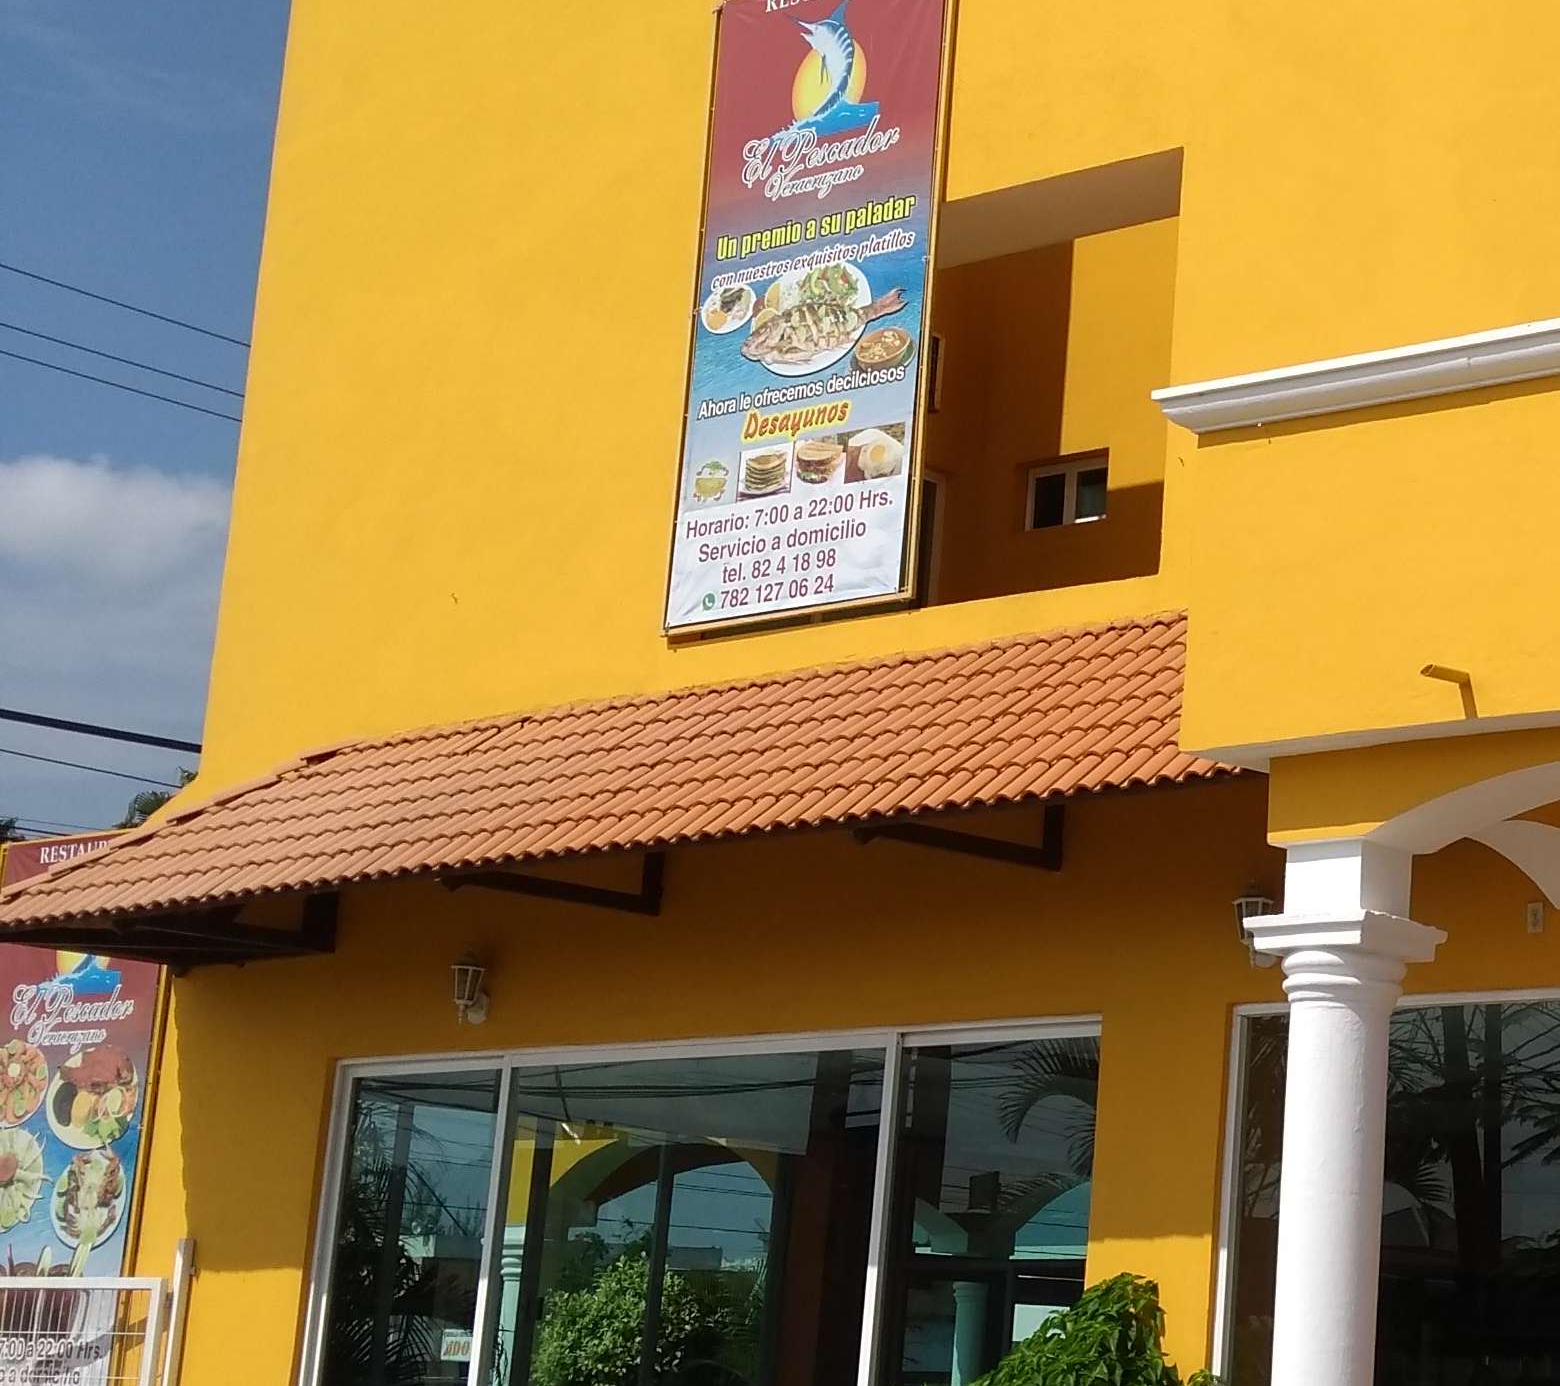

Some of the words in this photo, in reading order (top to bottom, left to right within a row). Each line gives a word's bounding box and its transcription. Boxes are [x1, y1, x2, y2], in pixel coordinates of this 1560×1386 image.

[742, 138, 779, 188] El
[780, 115, 900, 173] Pescador
[765, 165, 864, 201] Veracruzano
[716, 235, 738, 261] Un
[740, 220, 802, 259] premio
[805, 220, 816, 241] a
[820, 214, 841, 237] su
[844, 195, 916, 235] paladar
[711, 273, 736, 291] con
[737, 260, 792, 286] nuestros
[793, 244, 856, 274] exquisitos
[858, 229, 915, 262] platillos
[697, 395, 737, 420] Ahora
[739, 392, 752, 411] le
[753, 380, 823, 409] ofrecemos
[826, 365, 905, 394] decilciosos
[742, 401, 851, 441] Desayunos
[686, 513, 749, 539] Horario:
[754, 504, 789, 528] 7:00
[793, 506, 803, 520] a
[807, 493, 854, 518] 22:00
[859, 489, 893, 510] Hrs.
[698, 536, 766, 562] Servicio
[771, 535, 781, 550] a
[786, 518, 866, 548] domicilio
[722, 563, 746, 583] tel.
[752, 558, 771, 579] 82
[776, 556, 786, 575] 4
[793, 552, 811, 573] 18
[816, 548, 837, 569] 98
[720, 587, 749, 609] 782
[755, 582, 784, 604] 127
[788, 578, 809, 599] 06
[814, 574, 834, 595] 24
[10, 985, 43, 1031] El
[43, 984, 134, 1025] Pescador
[27, 1019, 107, 1055] Veracruzano
